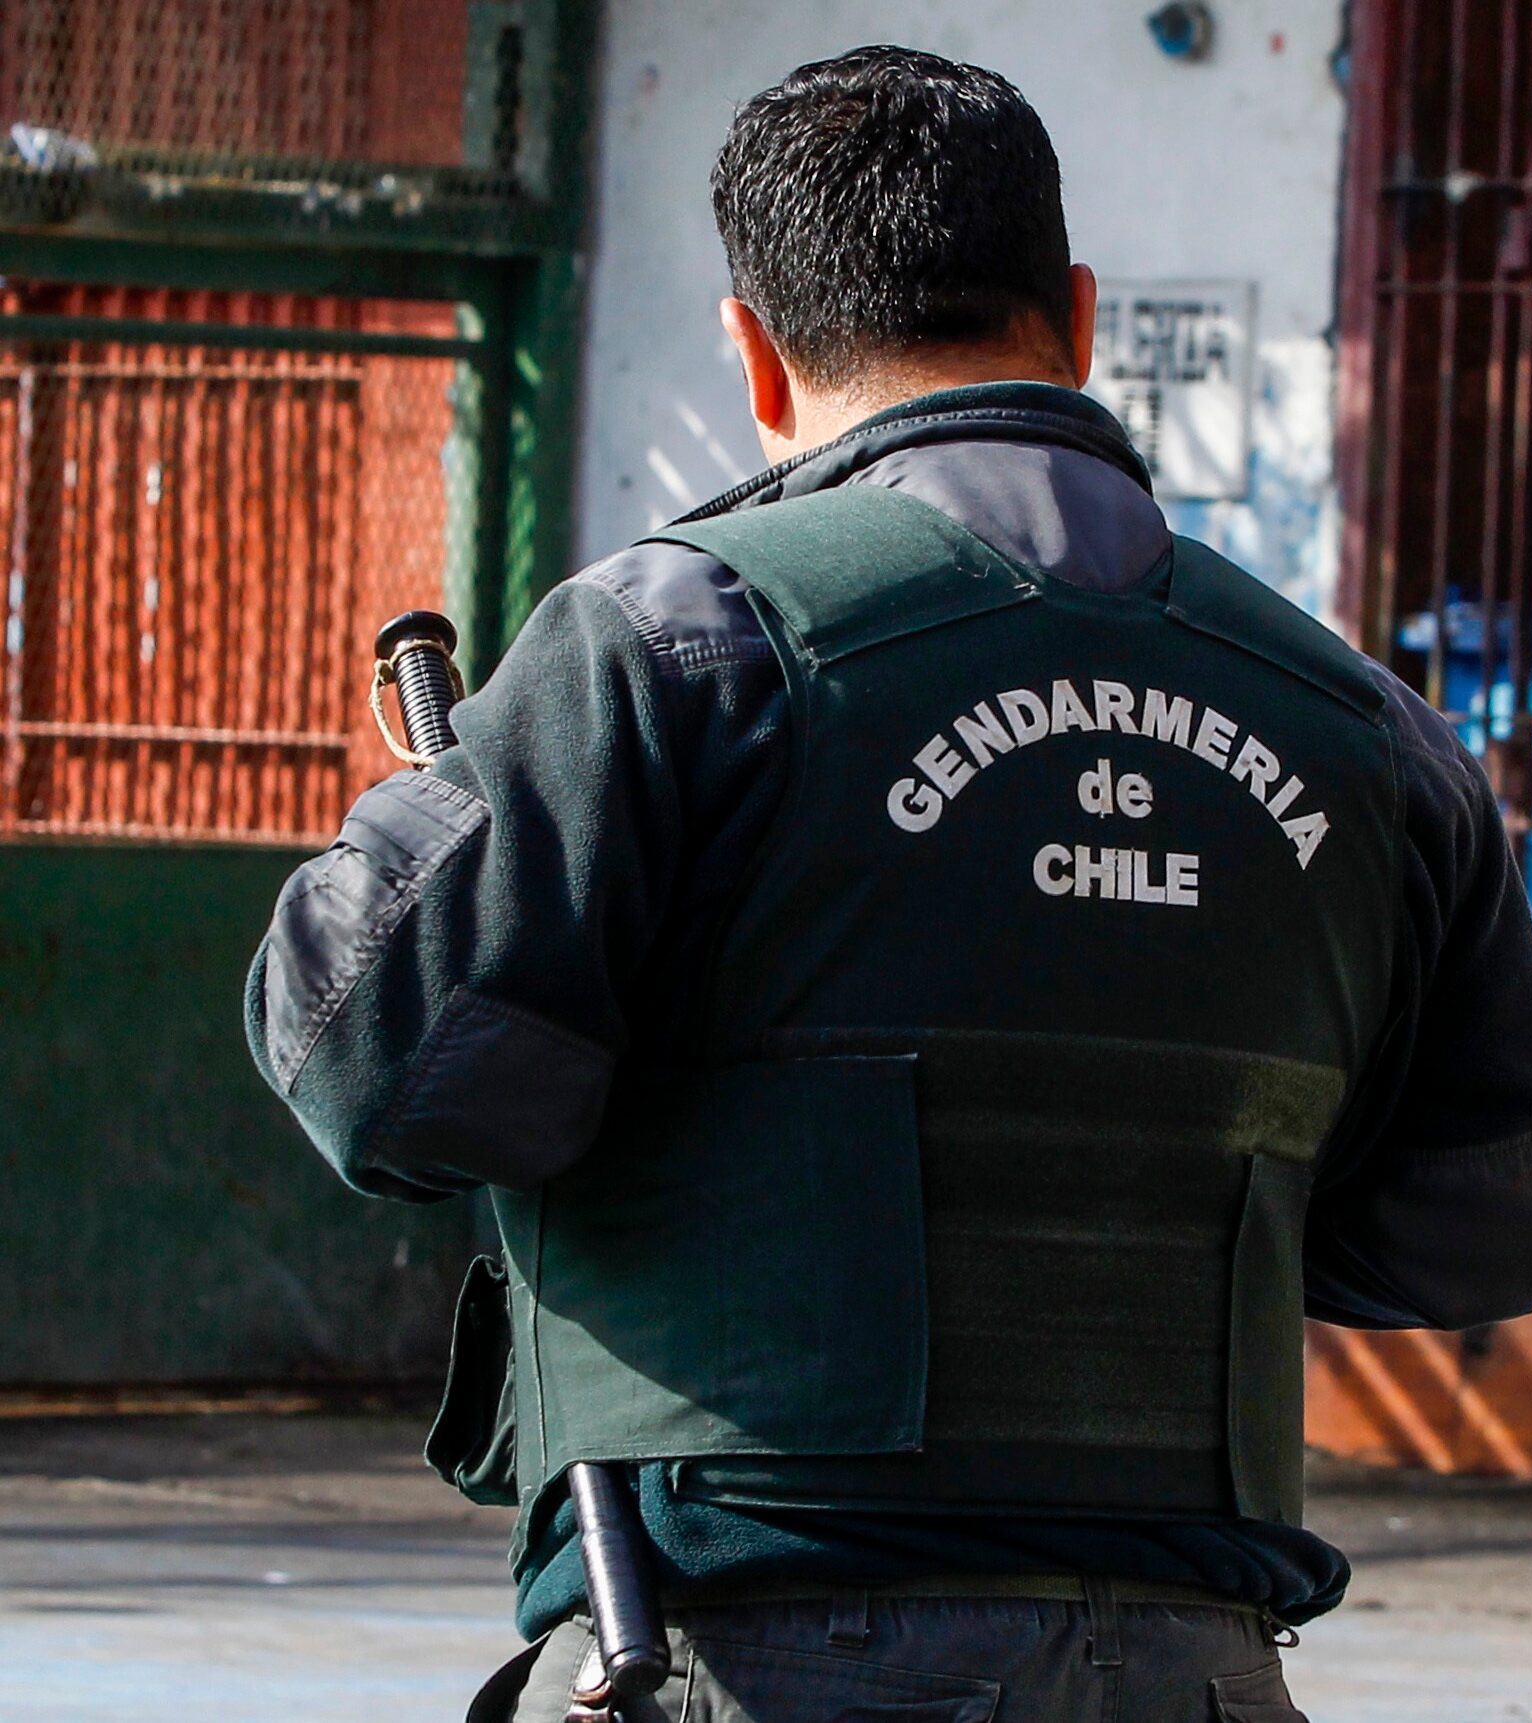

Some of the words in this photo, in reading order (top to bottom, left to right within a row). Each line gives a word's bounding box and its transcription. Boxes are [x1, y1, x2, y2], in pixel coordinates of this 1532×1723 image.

[887, 679, 1331, 870] GENDARMERIA
[1077, 758, 1154, 819] de
[1033, 843, 1200, 907] CHILE
